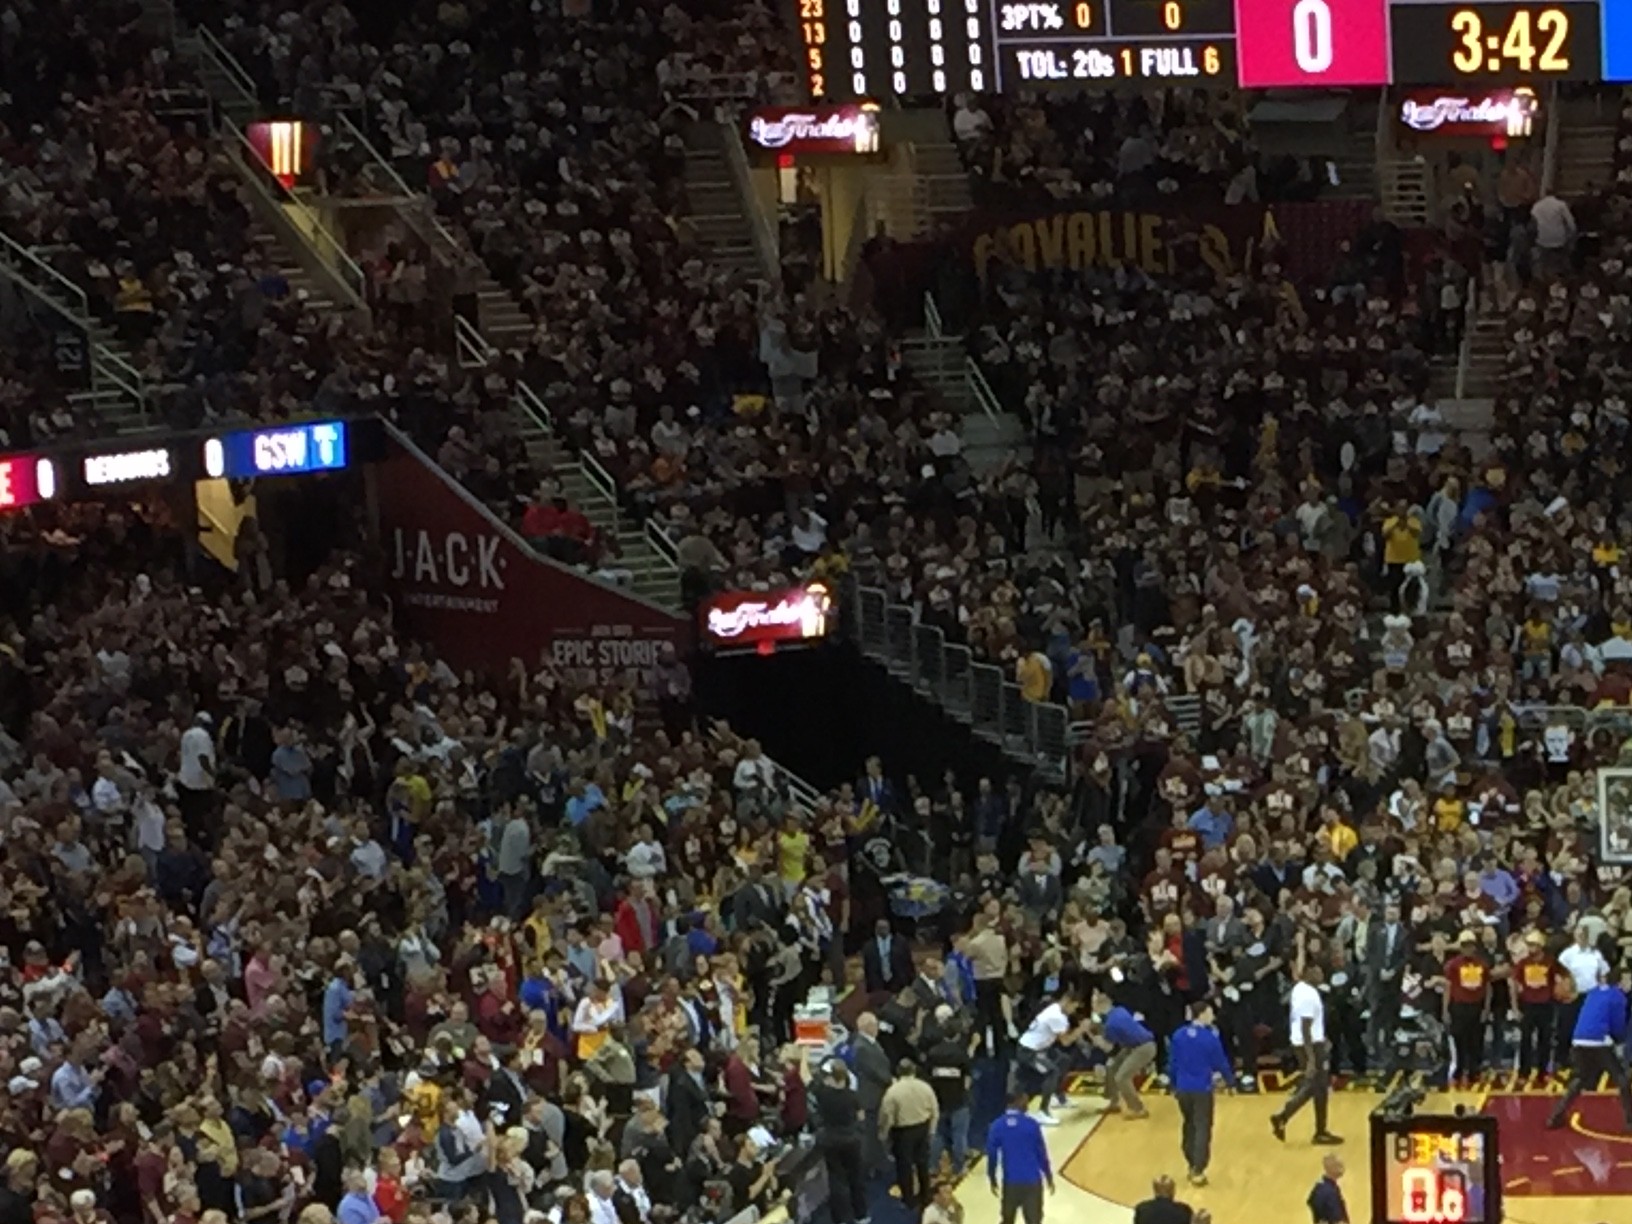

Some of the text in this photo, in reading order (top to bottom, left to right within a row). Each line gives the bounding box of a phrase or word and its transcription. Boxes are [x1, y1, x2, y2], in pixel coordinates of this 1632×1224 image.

[1001, 2, 1090, 30] 3PT% 0
[1165, 2, 1180, 30] 0
[802, 22, 825, 43] 13
[1291, 0, 1333, 73] 0
[1451, 9, 1568, 72] 3:42
[809, 48, 822, 70] 5
[1016, 46, 1220, 79] TOL: 20s 1 FULL 6
[811, 73, 824, 96] 2
[255, 431, 306, 471] GSW
[552, 640, 673, 668] EPIC STORIE
